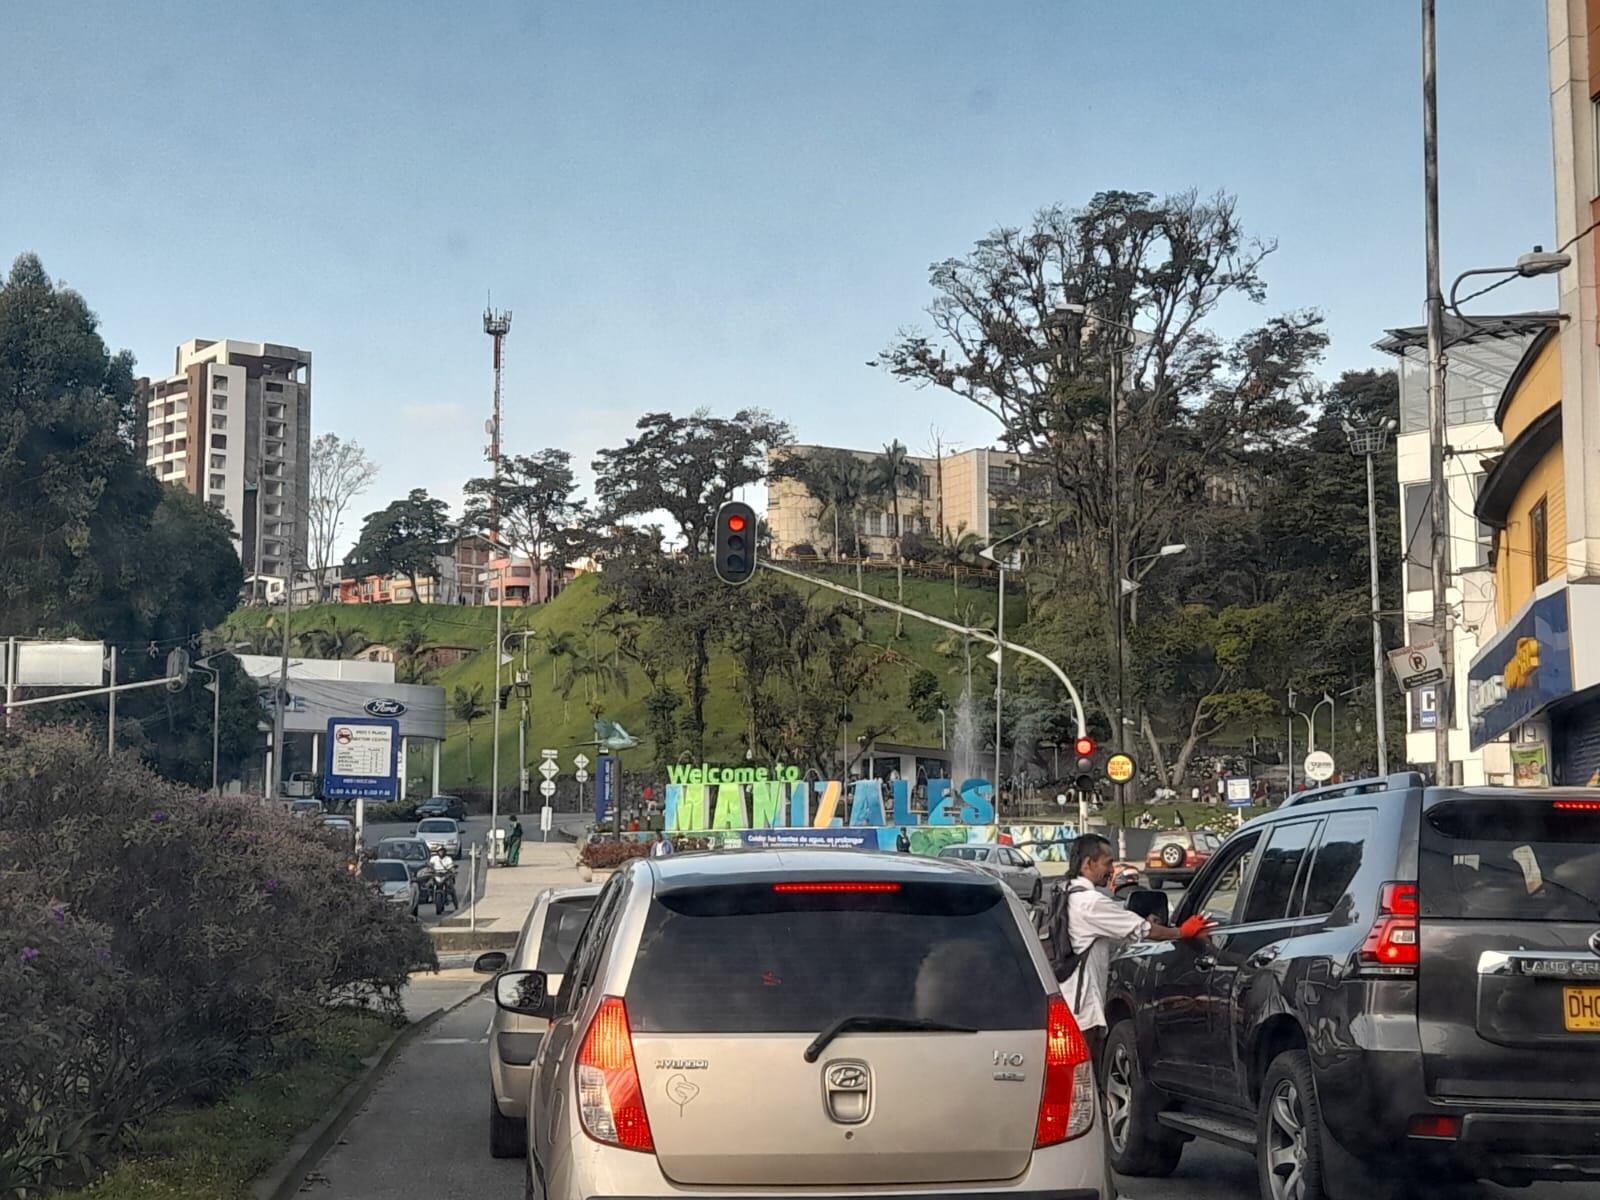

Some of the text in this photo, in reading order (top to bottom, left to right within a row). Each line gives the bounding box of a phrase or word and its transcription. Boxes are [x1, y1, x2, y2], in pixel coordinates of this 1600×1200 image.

[372, 701, 399, 713] Ford
[666, 762, 800, 784] Welcome to
[664, 778, 995, 832] MANIZALES
[1520, 960, 1569, 975] LAND
